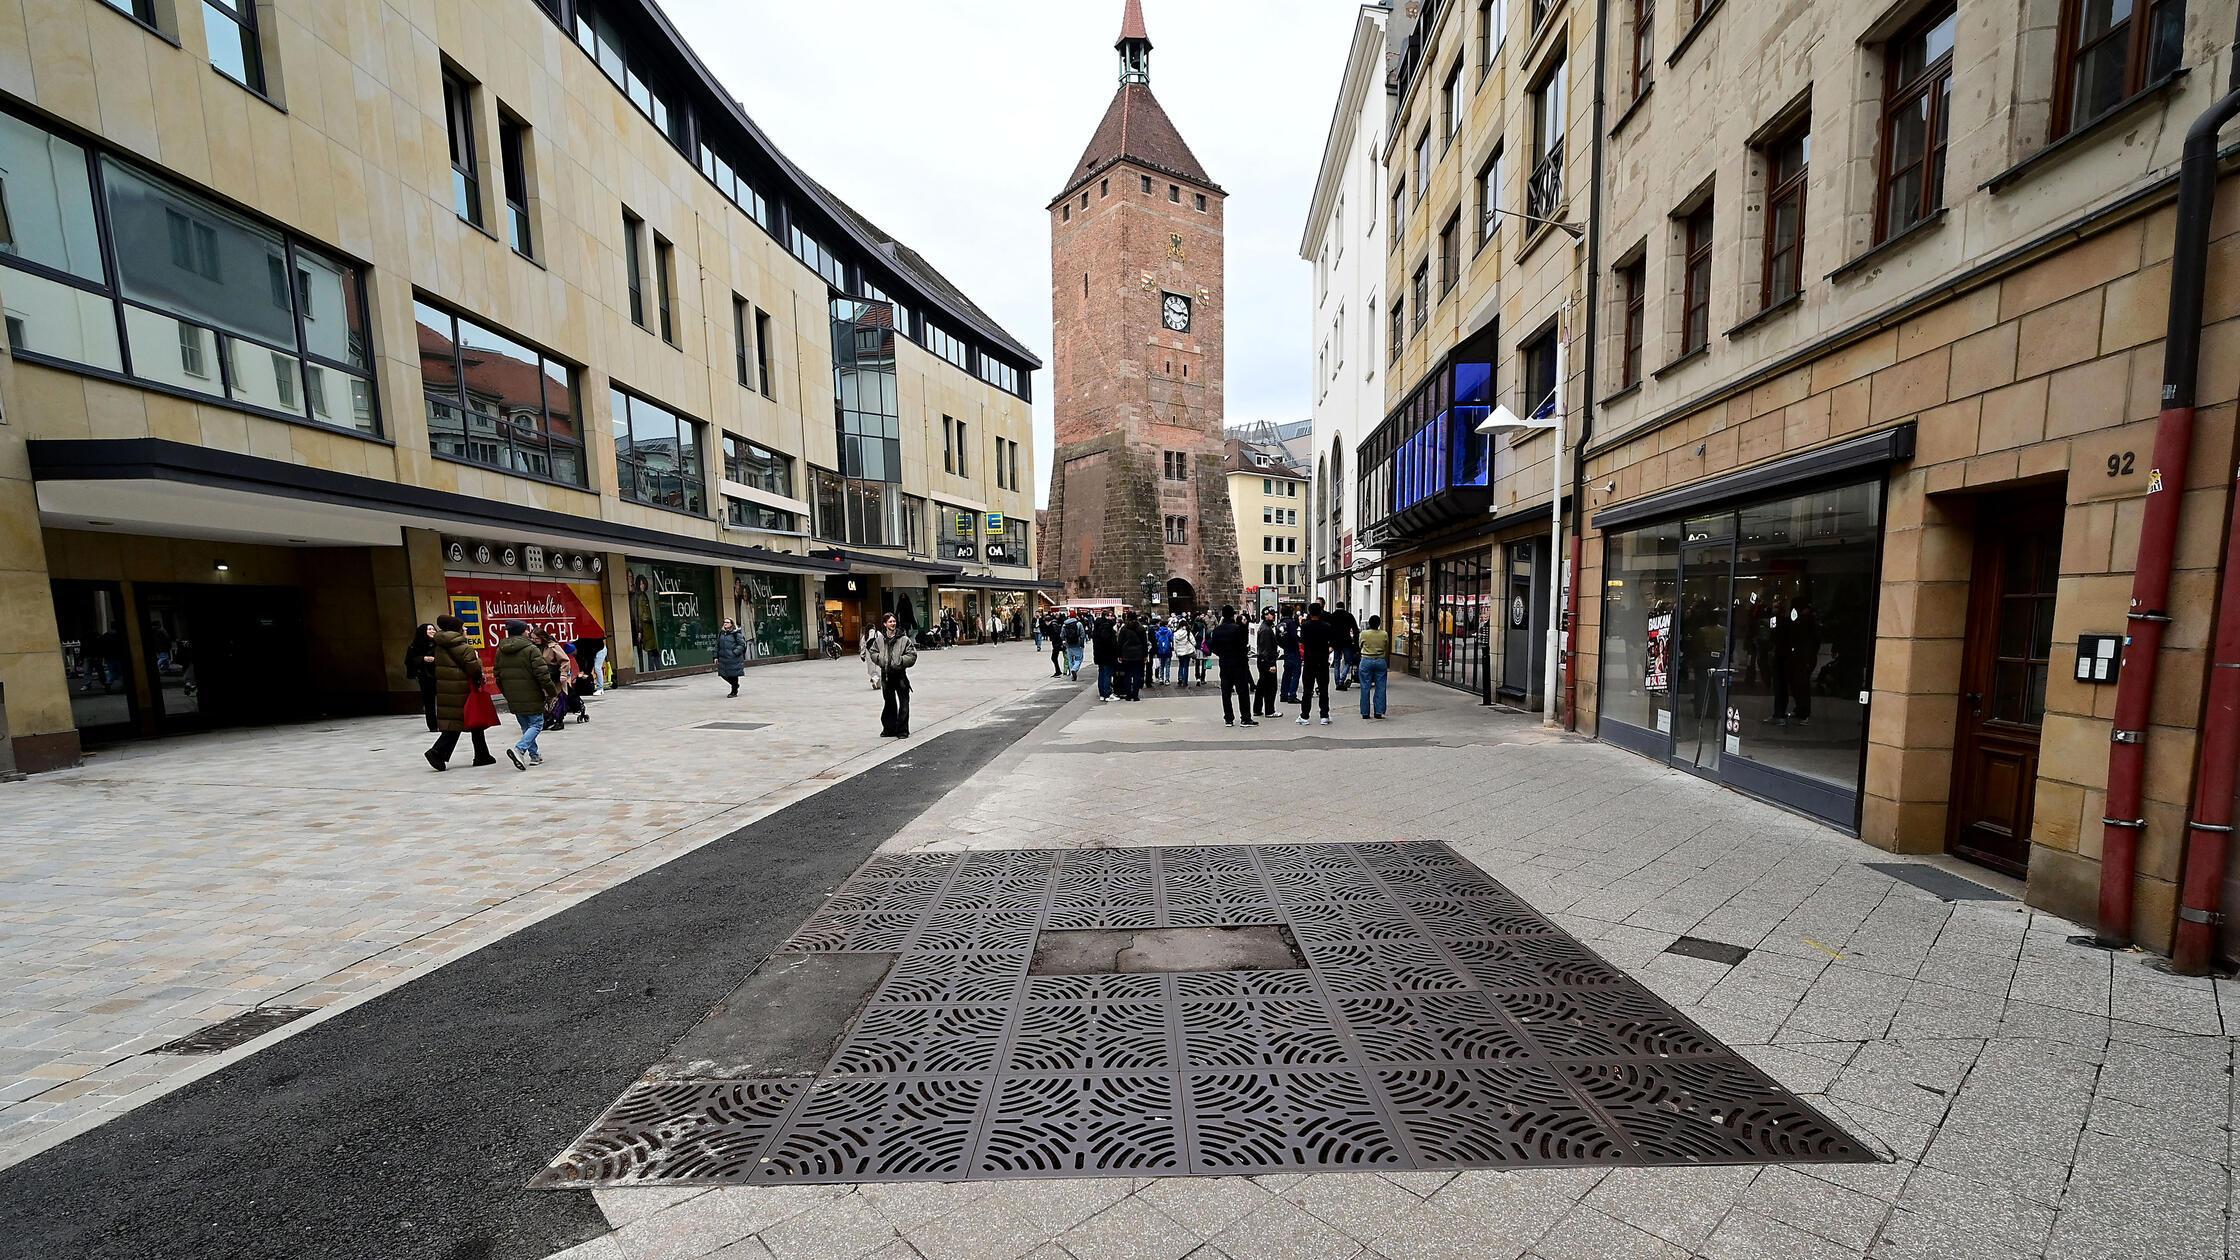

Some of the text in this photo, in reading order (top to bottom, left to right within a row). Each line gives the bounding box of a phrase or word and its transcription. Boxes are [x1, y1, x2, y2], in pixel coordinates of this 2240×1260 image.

[2107, 451, 2135, 477] 92
[653, 570, 681, 593] New
[752, 577, 774, 599] New
[486, 595, 566, 618] Kulinarikwelten
[671, 595, 699, 617] Look!
[766, 599, 787, 617] Look!
[1648, 614, 1671, 631] BALKAN
